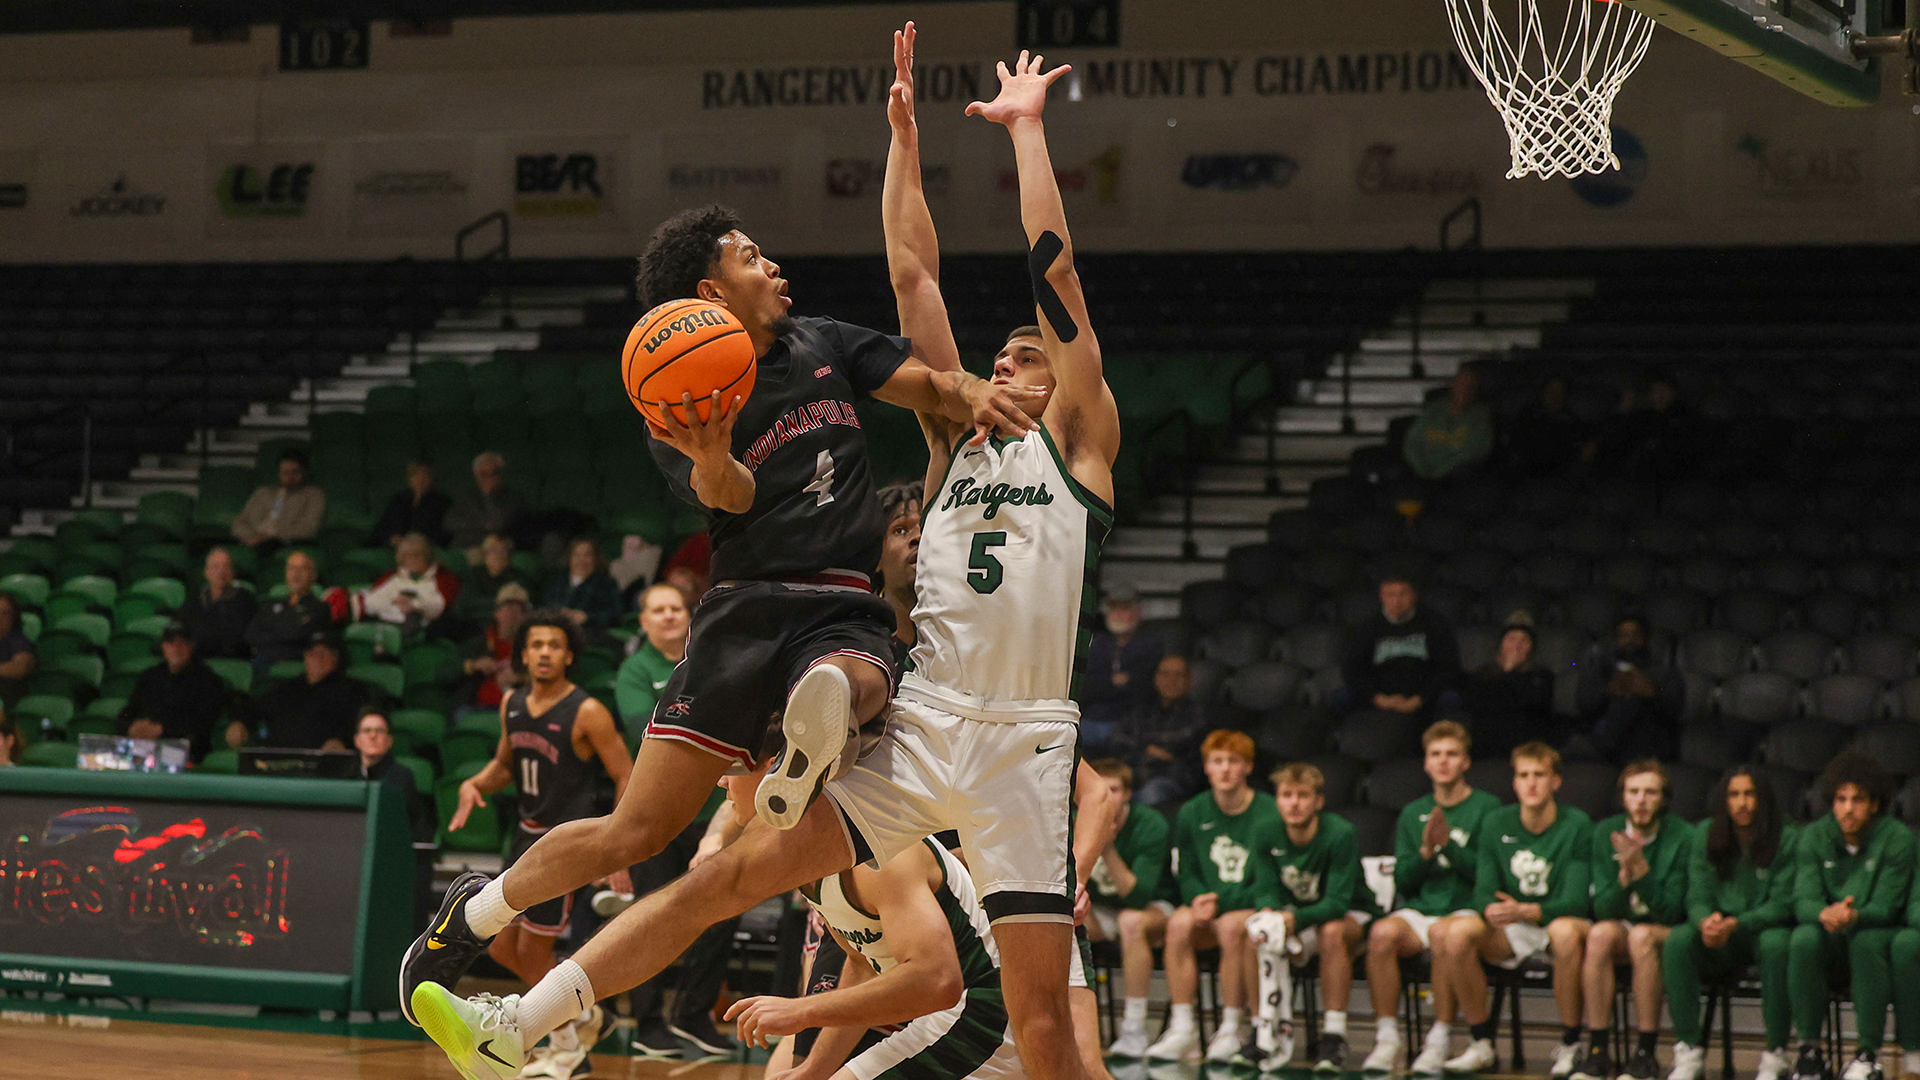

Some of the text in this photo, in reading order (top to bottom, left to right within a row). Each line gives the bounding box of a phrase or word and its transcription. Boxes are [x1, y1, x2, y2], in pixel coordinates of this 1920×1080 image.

[289, 28, 361, 67] 102
[1028, 5, 1108, 46] 104
[702, 51, 1494, 110] RANGERVIION MUNITY CHAMPION
[643, 309, 729, 354] Wilson
[742, 399, 861, 474] INDIANAPOLIS
[802, 448, 835, 507] 4
[941, 476, 1055, 520] Rangers
[966, 531, 1007, 595] 5
[521, 757, 540, 797] 11
